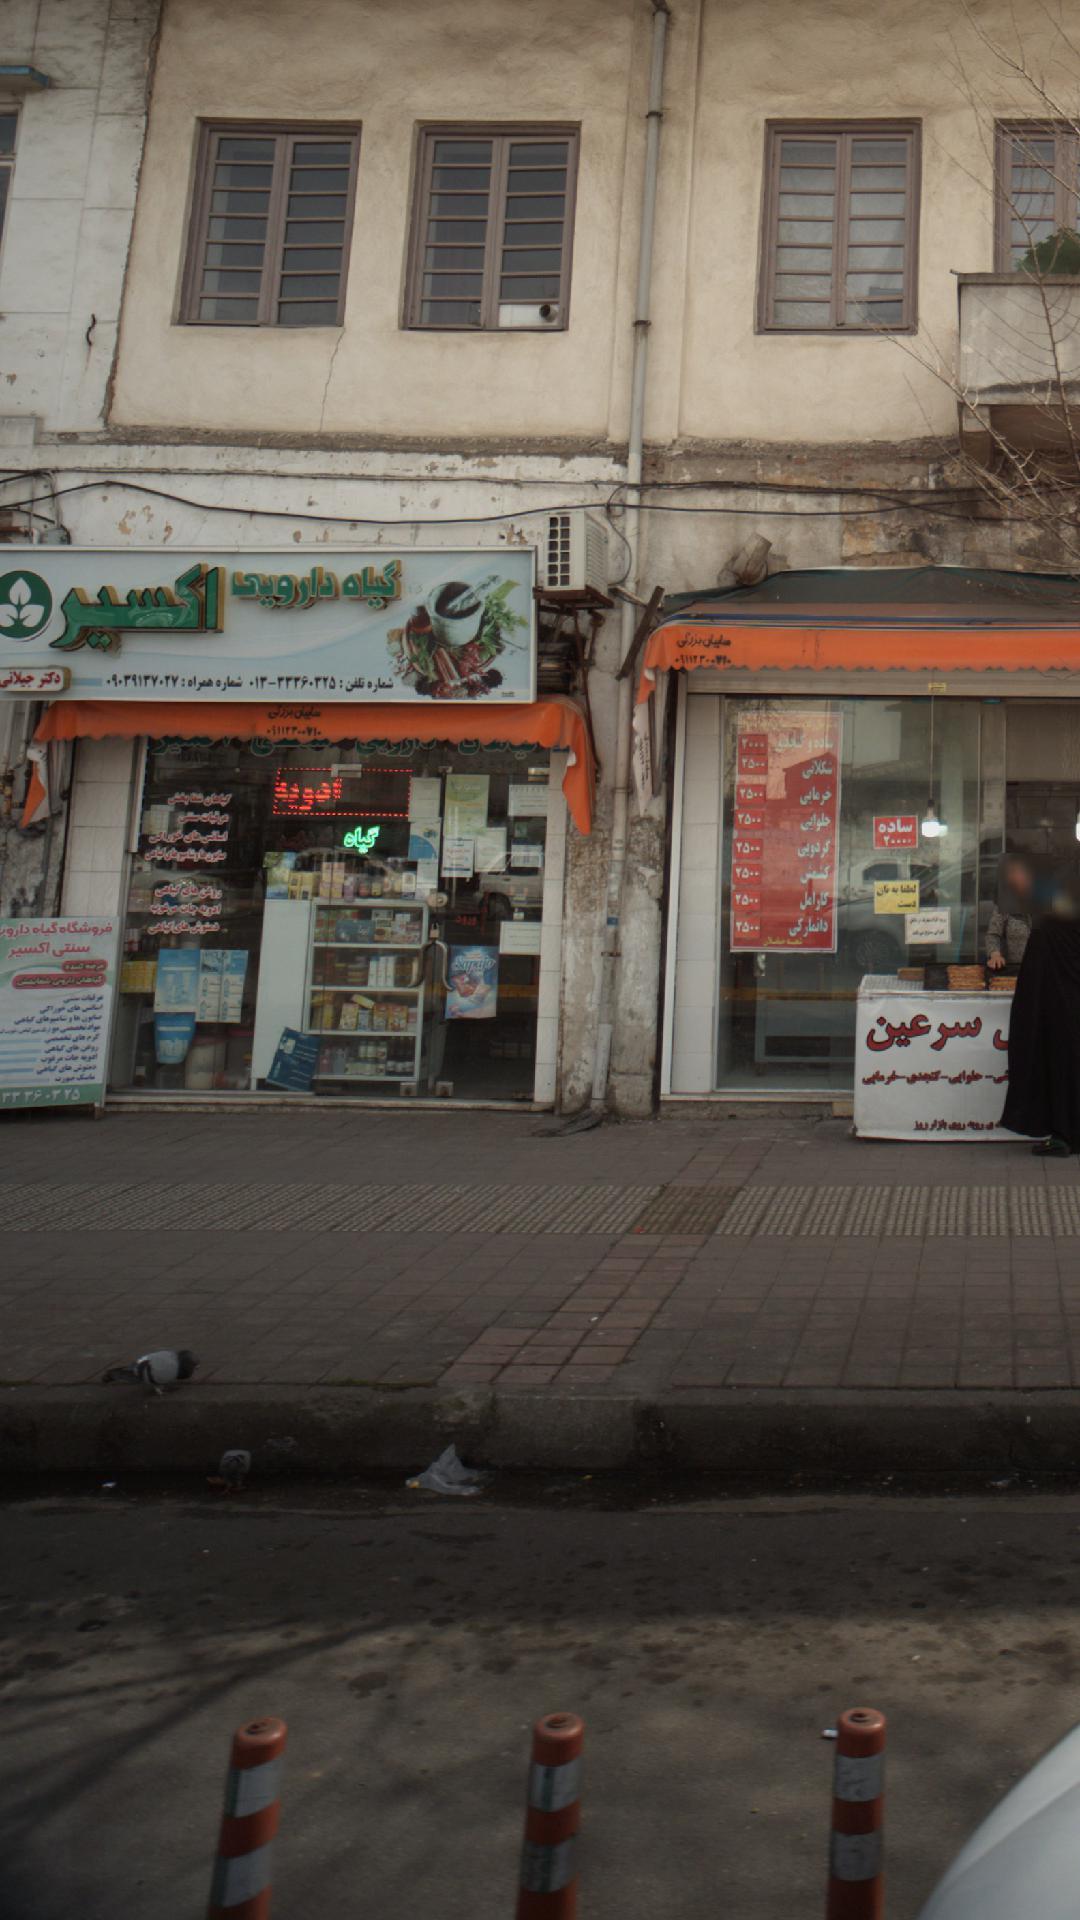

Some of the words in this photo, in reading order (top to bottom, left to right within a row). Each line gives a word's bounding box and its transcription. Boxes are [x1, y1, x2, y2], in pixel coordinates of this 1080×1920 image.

[232, 566, 338, 609] دارویی
[342, 559, 402, 608] گیاه
[49, 562, 226, 652] اکسیر
[216, 675, 243, 690] شماره
[367, 675, 394, 691] شماره
[800, 786, 832, 805] خرمایی
[800, 812, 831, 832] حلوایی
[878, 818, 913, 833] ساده
[343, 826, 380, 855] گیاه
[800, 890, 829, 911] کارامل
[32, 921, 58, 936] گیاه
[59, 921, 112, 936] فروشگاه
[789, 918, 828, 937] دانمارکی
[7, 942, 50, 959] اکسیر
[52, 943, 91, 958] سنتی
[867, 1014, 982, 1051] سرعین
